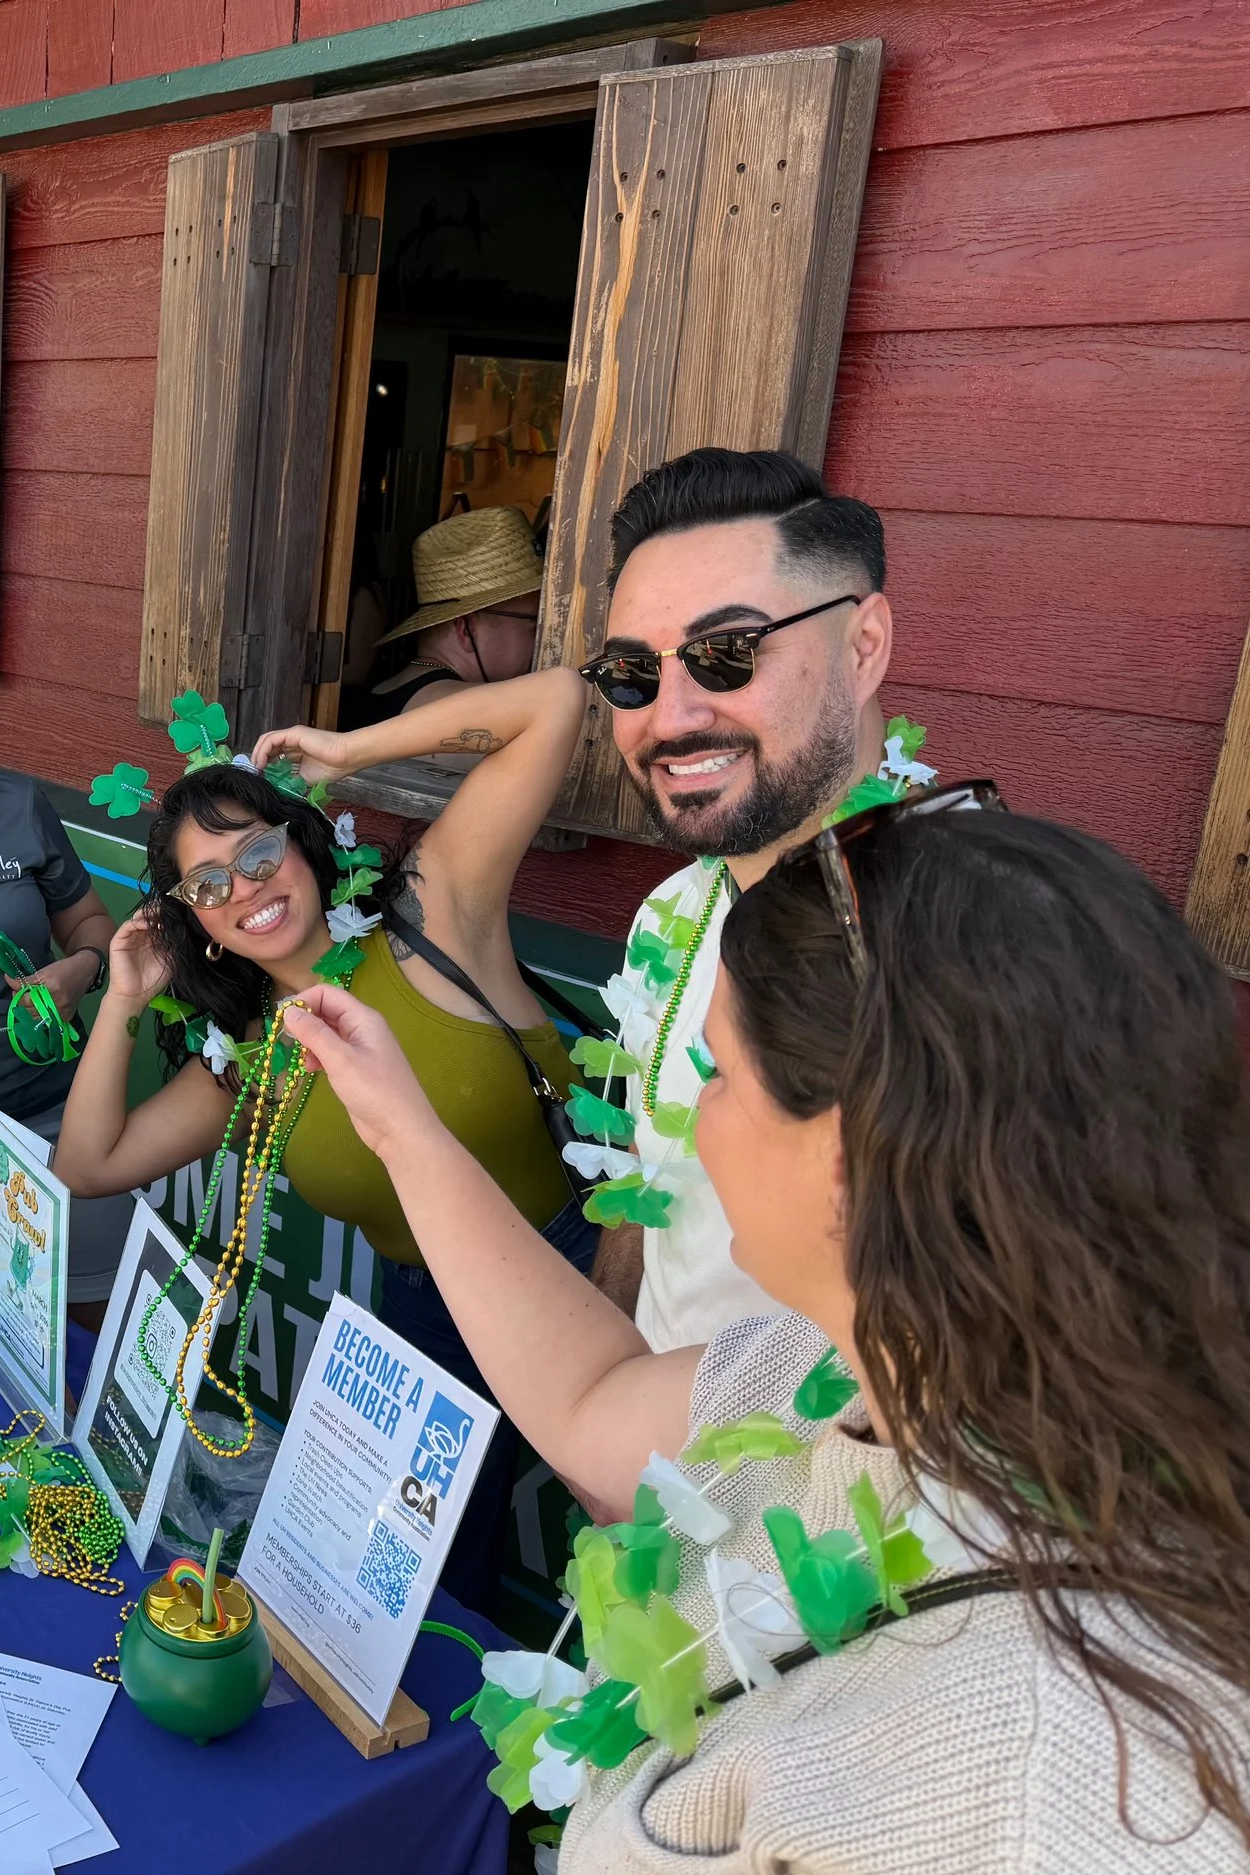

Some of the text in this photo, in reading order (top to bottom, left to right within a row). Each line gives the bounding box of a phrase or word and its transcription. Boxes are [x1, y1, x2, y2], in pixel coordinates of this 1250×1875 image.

[3, 1185, 46, 1255] Crawl
[11, 1170, 39, 1216] Pub
[321, 1352, 402, 1439] MEMBER
[333, 1318, 427, 1413] BECOME A
[106, 1394, 148, 1467] FOLLOW US ON
[309, 1408, 392, 1484] DIFFERENCE IN YOUR COMMUNITY!
[312, 1398, 388, 1467] JOIN UHCA TODAY AND MAKE A
[295, 1474, 322, 1503] Zone Watch
[299, 1466, 327, 1497] The UH News
[301, 1458, 361, 1518] Local events and programs
[302, 1428, 373, 1494] YOUR CONTRIBUTION SUPPORTS:
[303, 1450, 368, 1513] Neighborhood beautification
[307, 1442, 343, 1480] Trash Clean Ups
[407, 1445, 453, 1500] UH
[284, 1505, 313, 1538] UHCA Events
[286, 1498, 315, 1528] Garden Club
[289, 1491, 322, 1525] representation
[292, 1482, 351, 1541] Community advocacy and
[397, 1472, 443, 1526] CA
[261, 1544, 276, 1566] FOR
[275, 1559, 282, 1572] A
[281, 1565, 324, 1616] HOUSEHOLD
[265, 1532, 312, 1585] MEMBERSHIPS
[311, 1578, 335, 1608] START
[335, 1602, 346, 1619] AT
[345, 1612, 361, 1635] $36
[272, 1516, 374, 1621] ALL UH RESIDENTS AND BUSINESSES ARE WELCOME!
[21, 1671, 41, 1680] Heights
